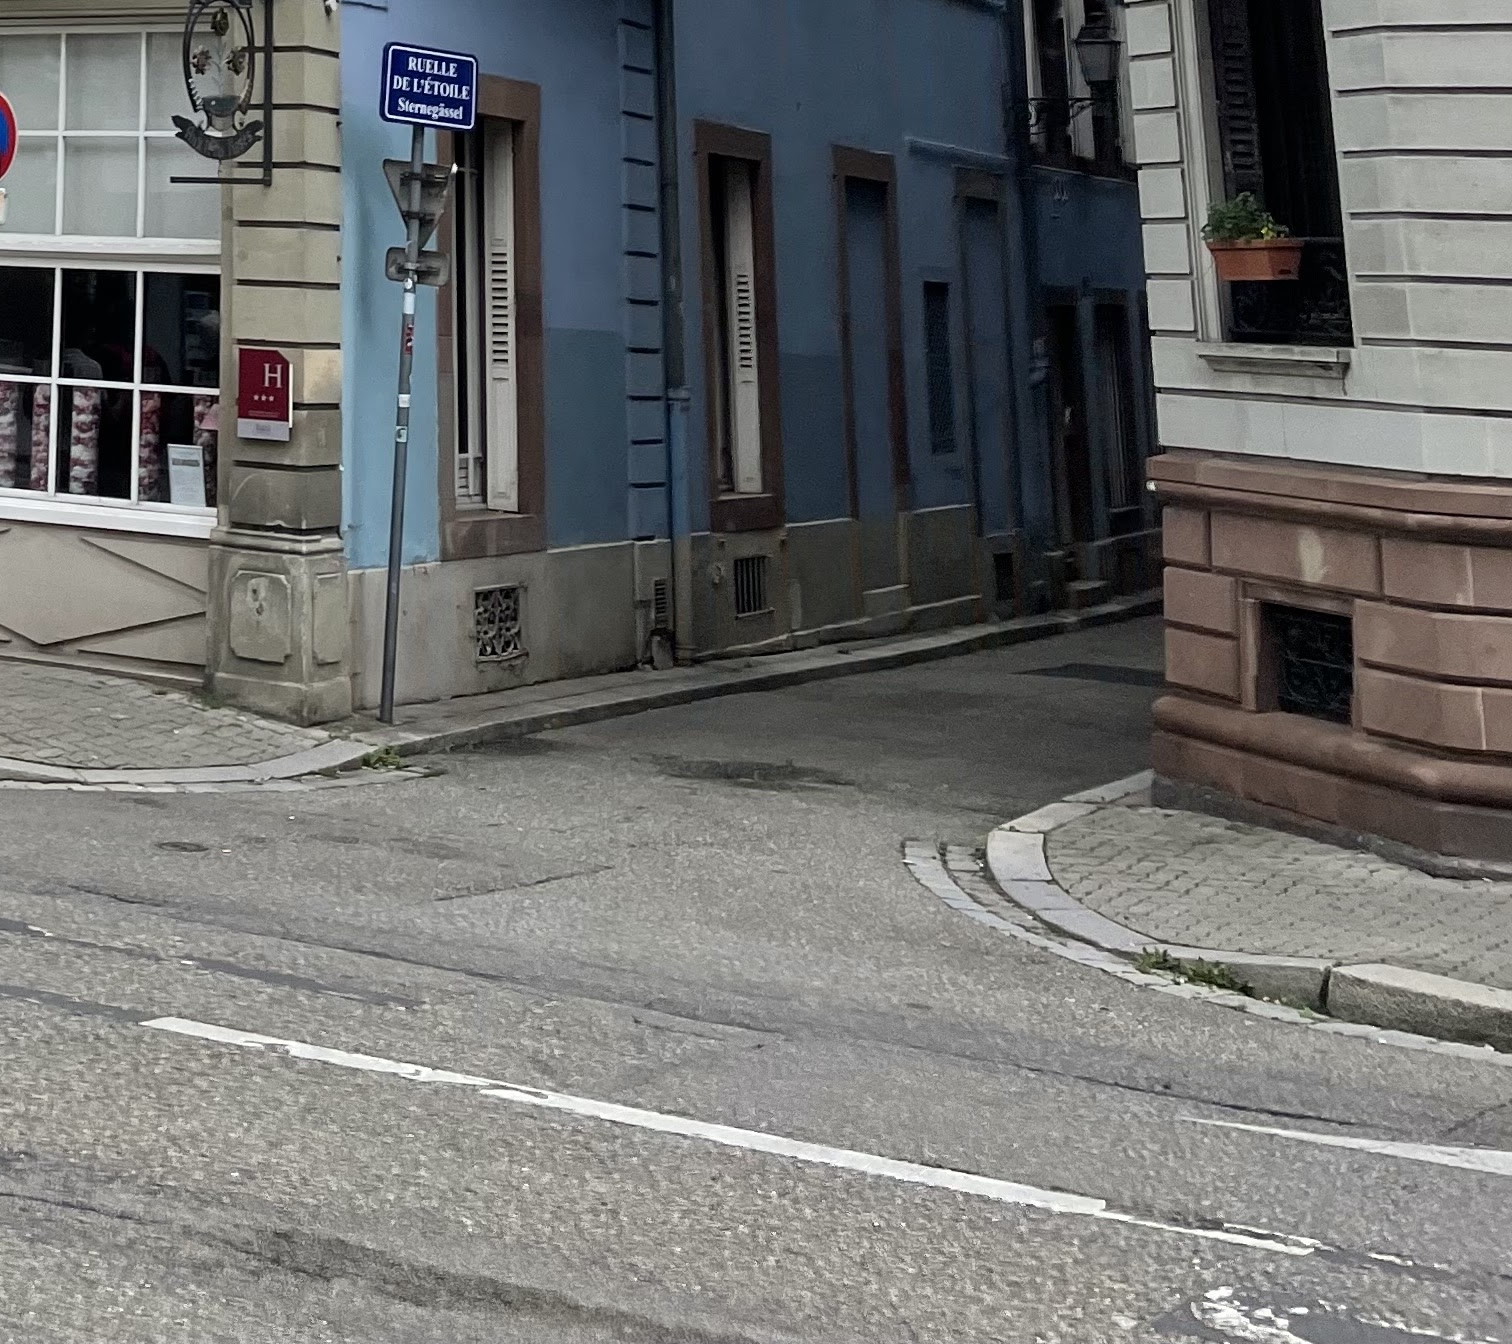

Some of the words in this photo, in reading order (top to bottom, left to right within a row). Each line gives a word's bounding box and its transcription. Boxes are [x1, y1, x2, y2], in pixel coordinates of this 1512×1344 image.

[407, 56, 458, 78] RUELLE
[392, 75, 411, 91] DE
[413, 77, 471, 100] L'ÉTOILE
[397, 96, 464, 120] Sternegässel
[263, 362, 283, 389] H
